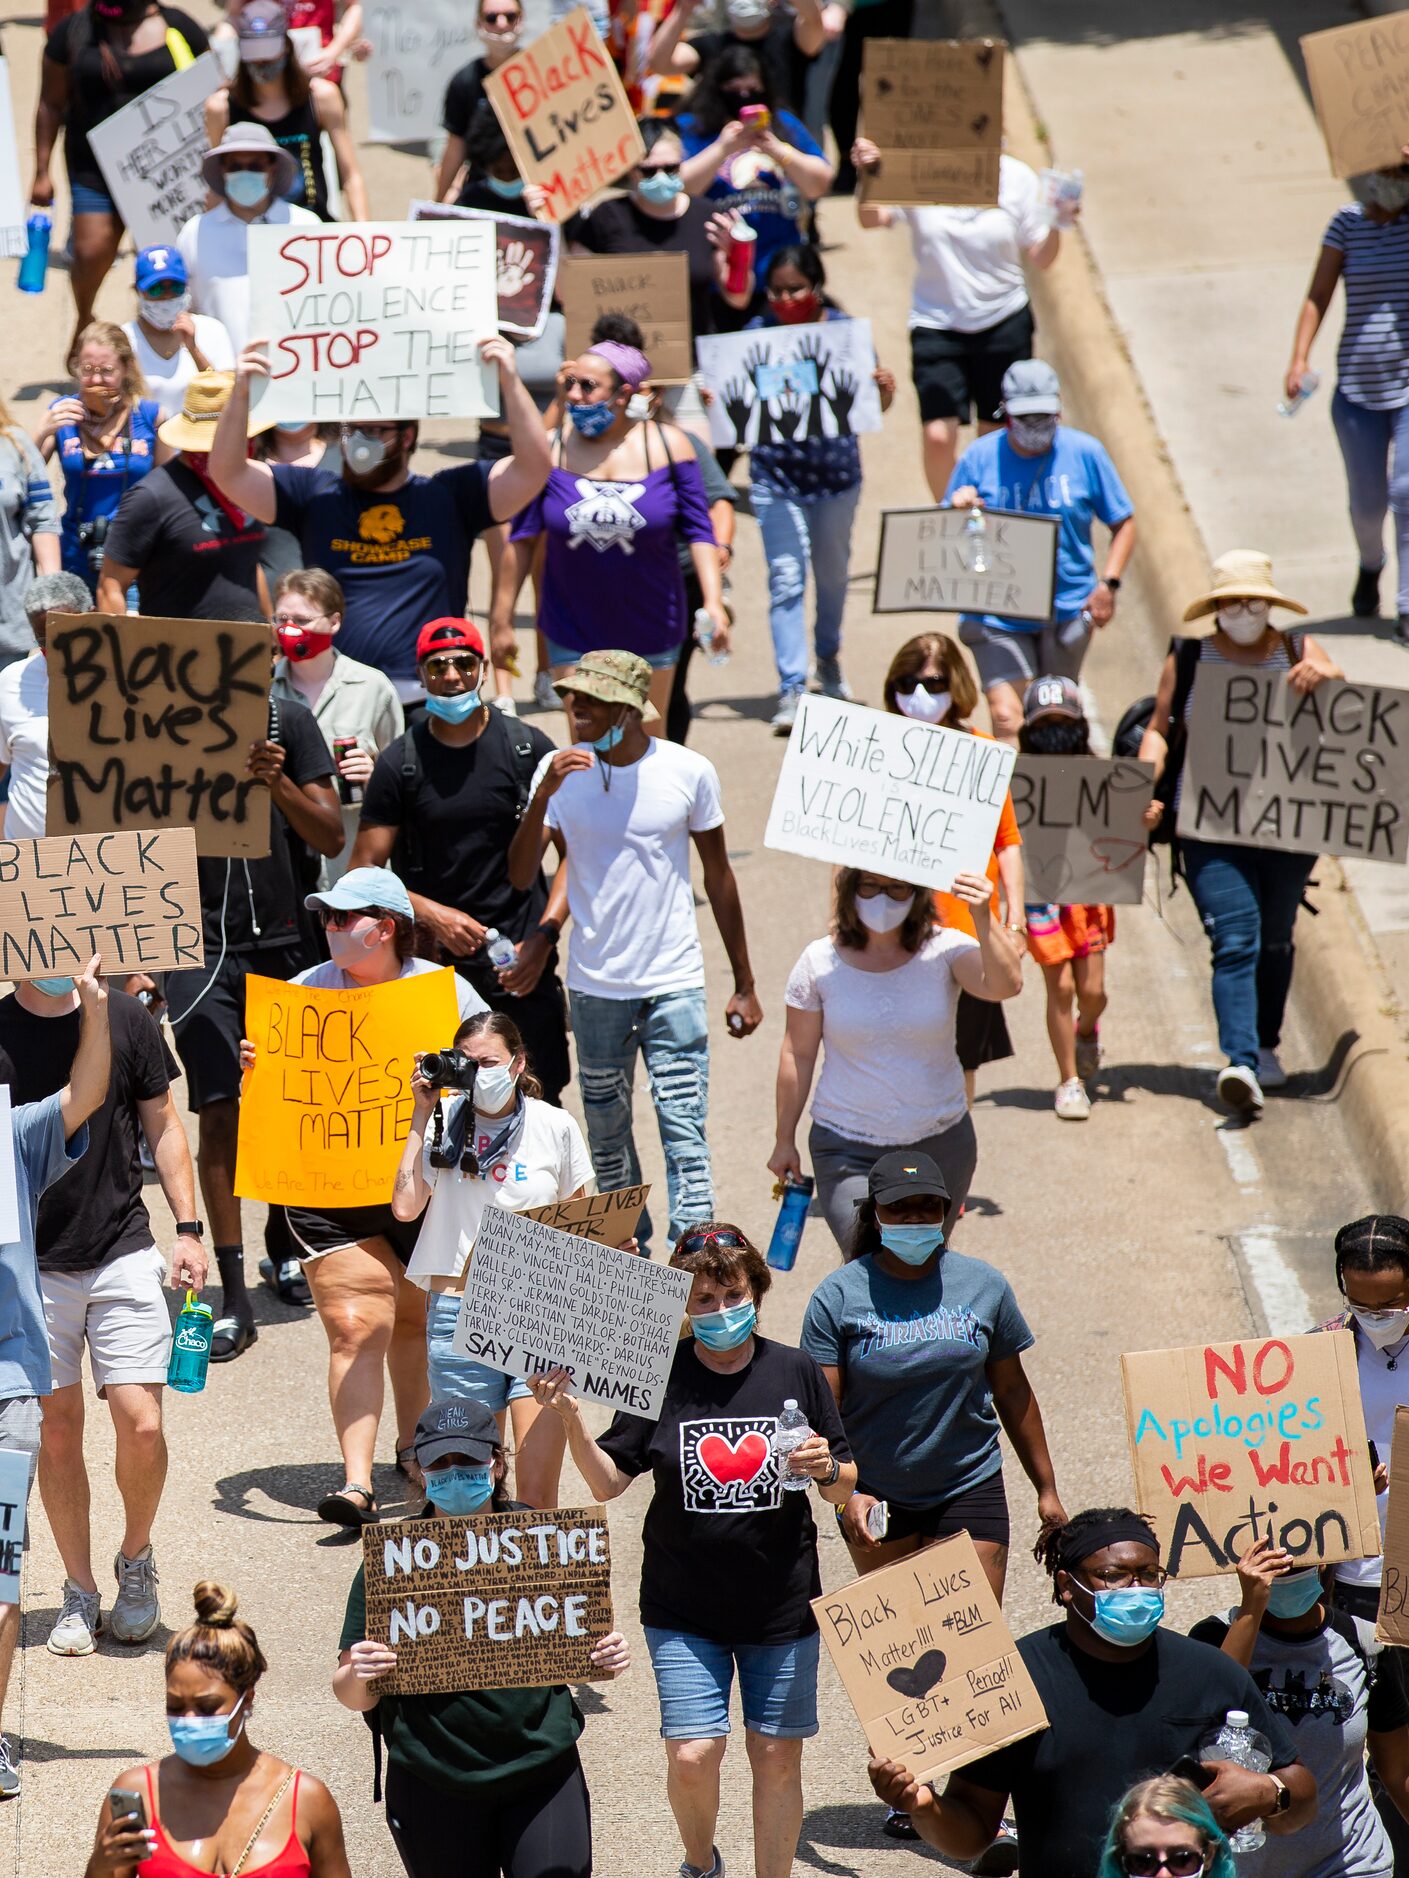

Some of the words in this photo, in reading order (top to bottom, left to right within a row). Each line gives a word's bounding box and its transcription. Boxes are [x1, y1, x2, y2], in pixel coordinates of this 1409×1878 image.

[500, 21, 607, 120] Black
[523, 82, 615, 162] Lives
[538, 134, 633, 219] Matter
[280, 234, 392, 295] STOP
[401, 235, 482, 272] THE
[285, 284, 469, 329] VIOLENCE
[272, 329, 379, 379] STOP
[393, 330, 474, 369] THE
[312, 372, 455, 416] HATE
[331, 537, 432, 551] SHOWCASE
[350, 550, 411, 563] CAMP
[904, 576, 1022, 609] MATTER
[53, 623, 268, 706] Black
[90, 694, 237, 753] Lives
[1225, 676, 1400, 746] BLACK
[800, 706, 885, 773] White
[889, 726, 1013, 807] SILENCE
[1227, 734, 1384, 793] LIVES
[57, 757, 270, 825] Matter
[802, 776, 964, 851] VIOLENCE
[1012, 774, 1111, 828] BLM
[1195, 786, 1400, 856] MATTER
[882, 834, 942, 870] Matter
[21, 881, 185, 922] LIVES
[3, 922, 201, 975] MATTER
[268, 1003, 372, 1063] BLACK
[283, 1059, 402, 1106] LIVES
[587, 1185, 651, 1217] LIVES
[482, 1220, 512, 1241] JUAN
[526, 1222, 558, 1243] CRANE
[473, 1271, 496, 1286] HIGH
[524, 1288, 576, 1312] JERMAINE
[523, 1253, 572, 1277] VINCENT
[611, 1282, 654, 1304] PHILLIP
[529, 1271, 566, 1293] KELVIN
[632, 1305, 673, 1327] CARLOS
[178, 1336, 205, 1348] Chaco
[504, 1312, 550, 1336] JORDAN
[614, 1347, 654, 1369] DARIUS
[508, 1328, 566, 1357] CLEVONTA
[510, 1298, 566, 1325] CHRISTIAN
[623, 1333, 669, 1358] BOTHAM
[858, 1304, 981, 1359] THRASHER
[465, 1333, 514, 1366] SAY
[583, 1373, 651, 1411] NAMES
[1204, 1340, 1295, 1400] NO
[437, 1417, 469, 1430] GIRLS
[440, 1406, 465, 1417] MEAN
[1136, 1397, 1325, 1459] Apologies
[1161, 1454, 1234, 1497] We
[1248, 1436, 1356, 1488] Want
[384, 1536, 441, 1578] NO
[456, 1525, 607, 1571] JUSTICE
[390, 1602, 441, 1645] NO
[464, 1595, 589, 1641] PEACE
[825, 1594, 897, 1646] Black
[914, 1569, 971, 1606] Lives
[859, 1625, 935, 1676] Matter!!!!
[942, 1604, 983, 1632] #BLM
[886, 1695, 949, 1736] LGBT+
[905, 1725, 963, 1755] Justice
[966, 1709, 990, 1730] For
[999, 1691, 1022, 1716] All
